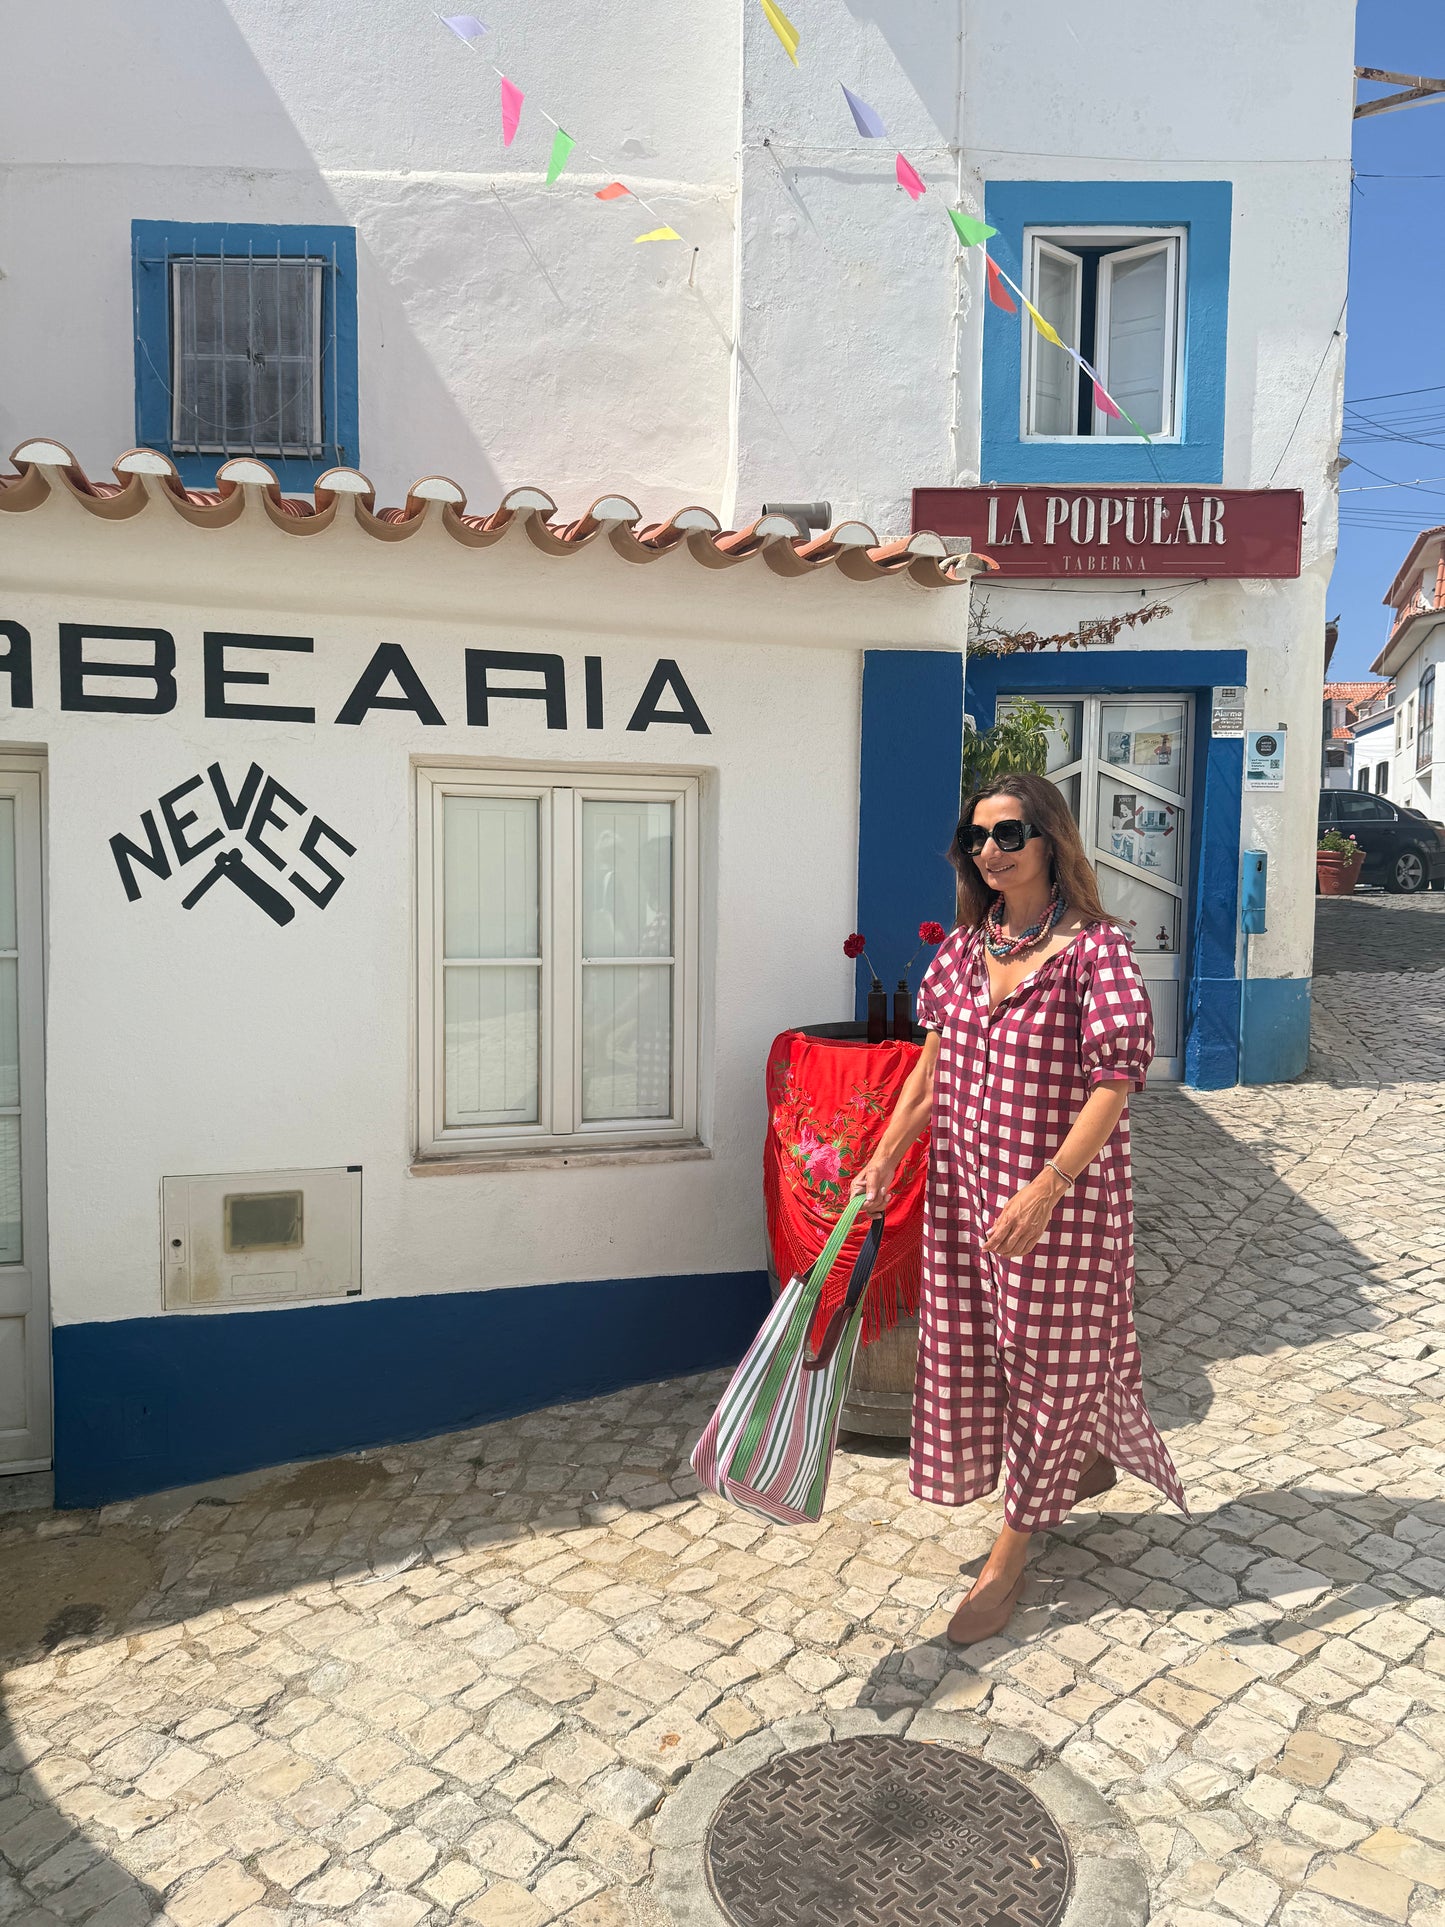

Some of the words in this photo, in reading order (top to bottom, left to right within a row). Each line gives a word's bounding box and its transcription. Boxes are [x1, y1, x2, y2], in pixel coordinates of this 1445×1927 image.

[985, 496, 1034, 546] LA
[1043, 496, 1227, 546] POPULAR
[1063, 556, 1147, 571] TABERNA
[109, 761, 357, 910] NEVES
[869, 1790, 973, 1859] ESGOTOS
[886, 1782, 983, 1848] DOMESTICOS
